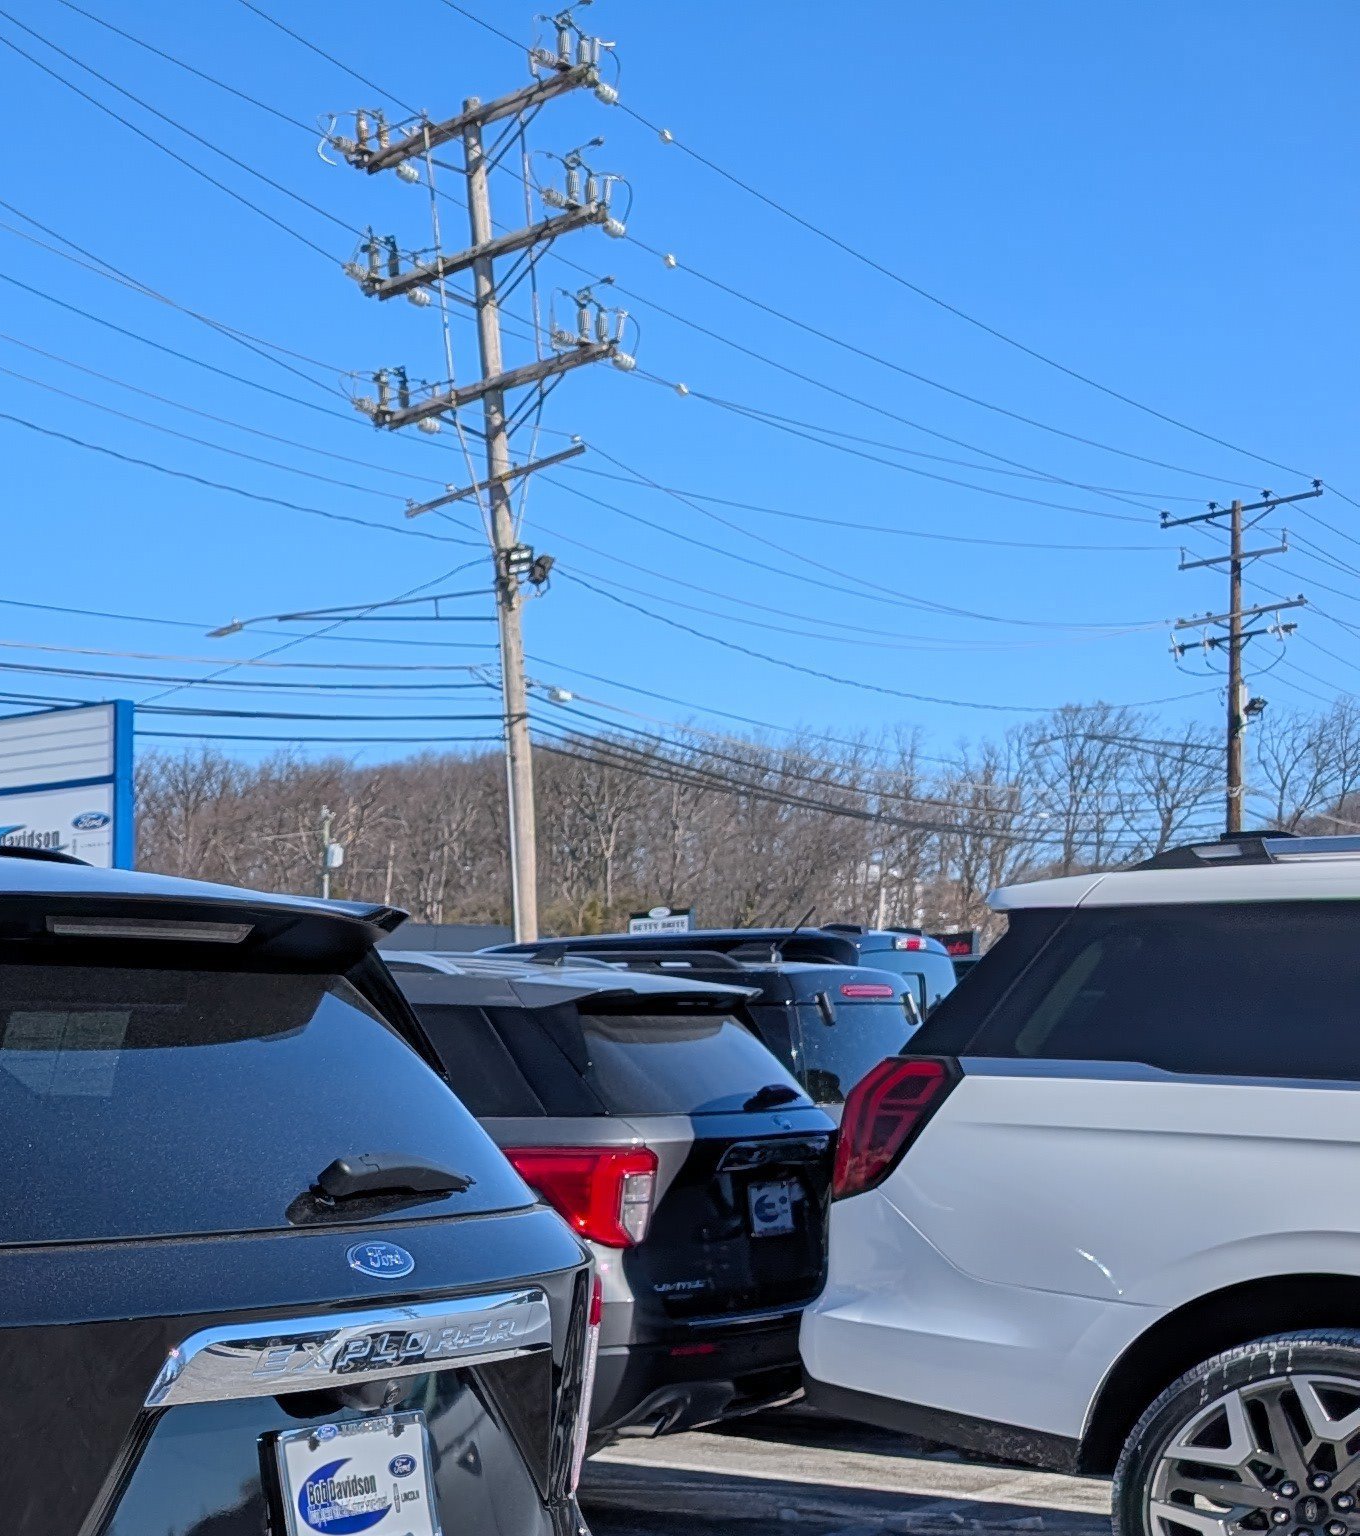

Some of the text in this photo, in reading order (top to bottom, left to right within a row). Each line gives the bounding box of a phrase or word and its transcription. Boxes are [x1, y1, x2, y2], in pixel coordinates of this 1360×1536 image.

[0, 830, 61, 849] Davidson
[365, 1246, 405, 1268] Ford
[252, 1319, 518, 1377] EXPLORER
[307, 1474, 378, 1505] Bob Davidson
